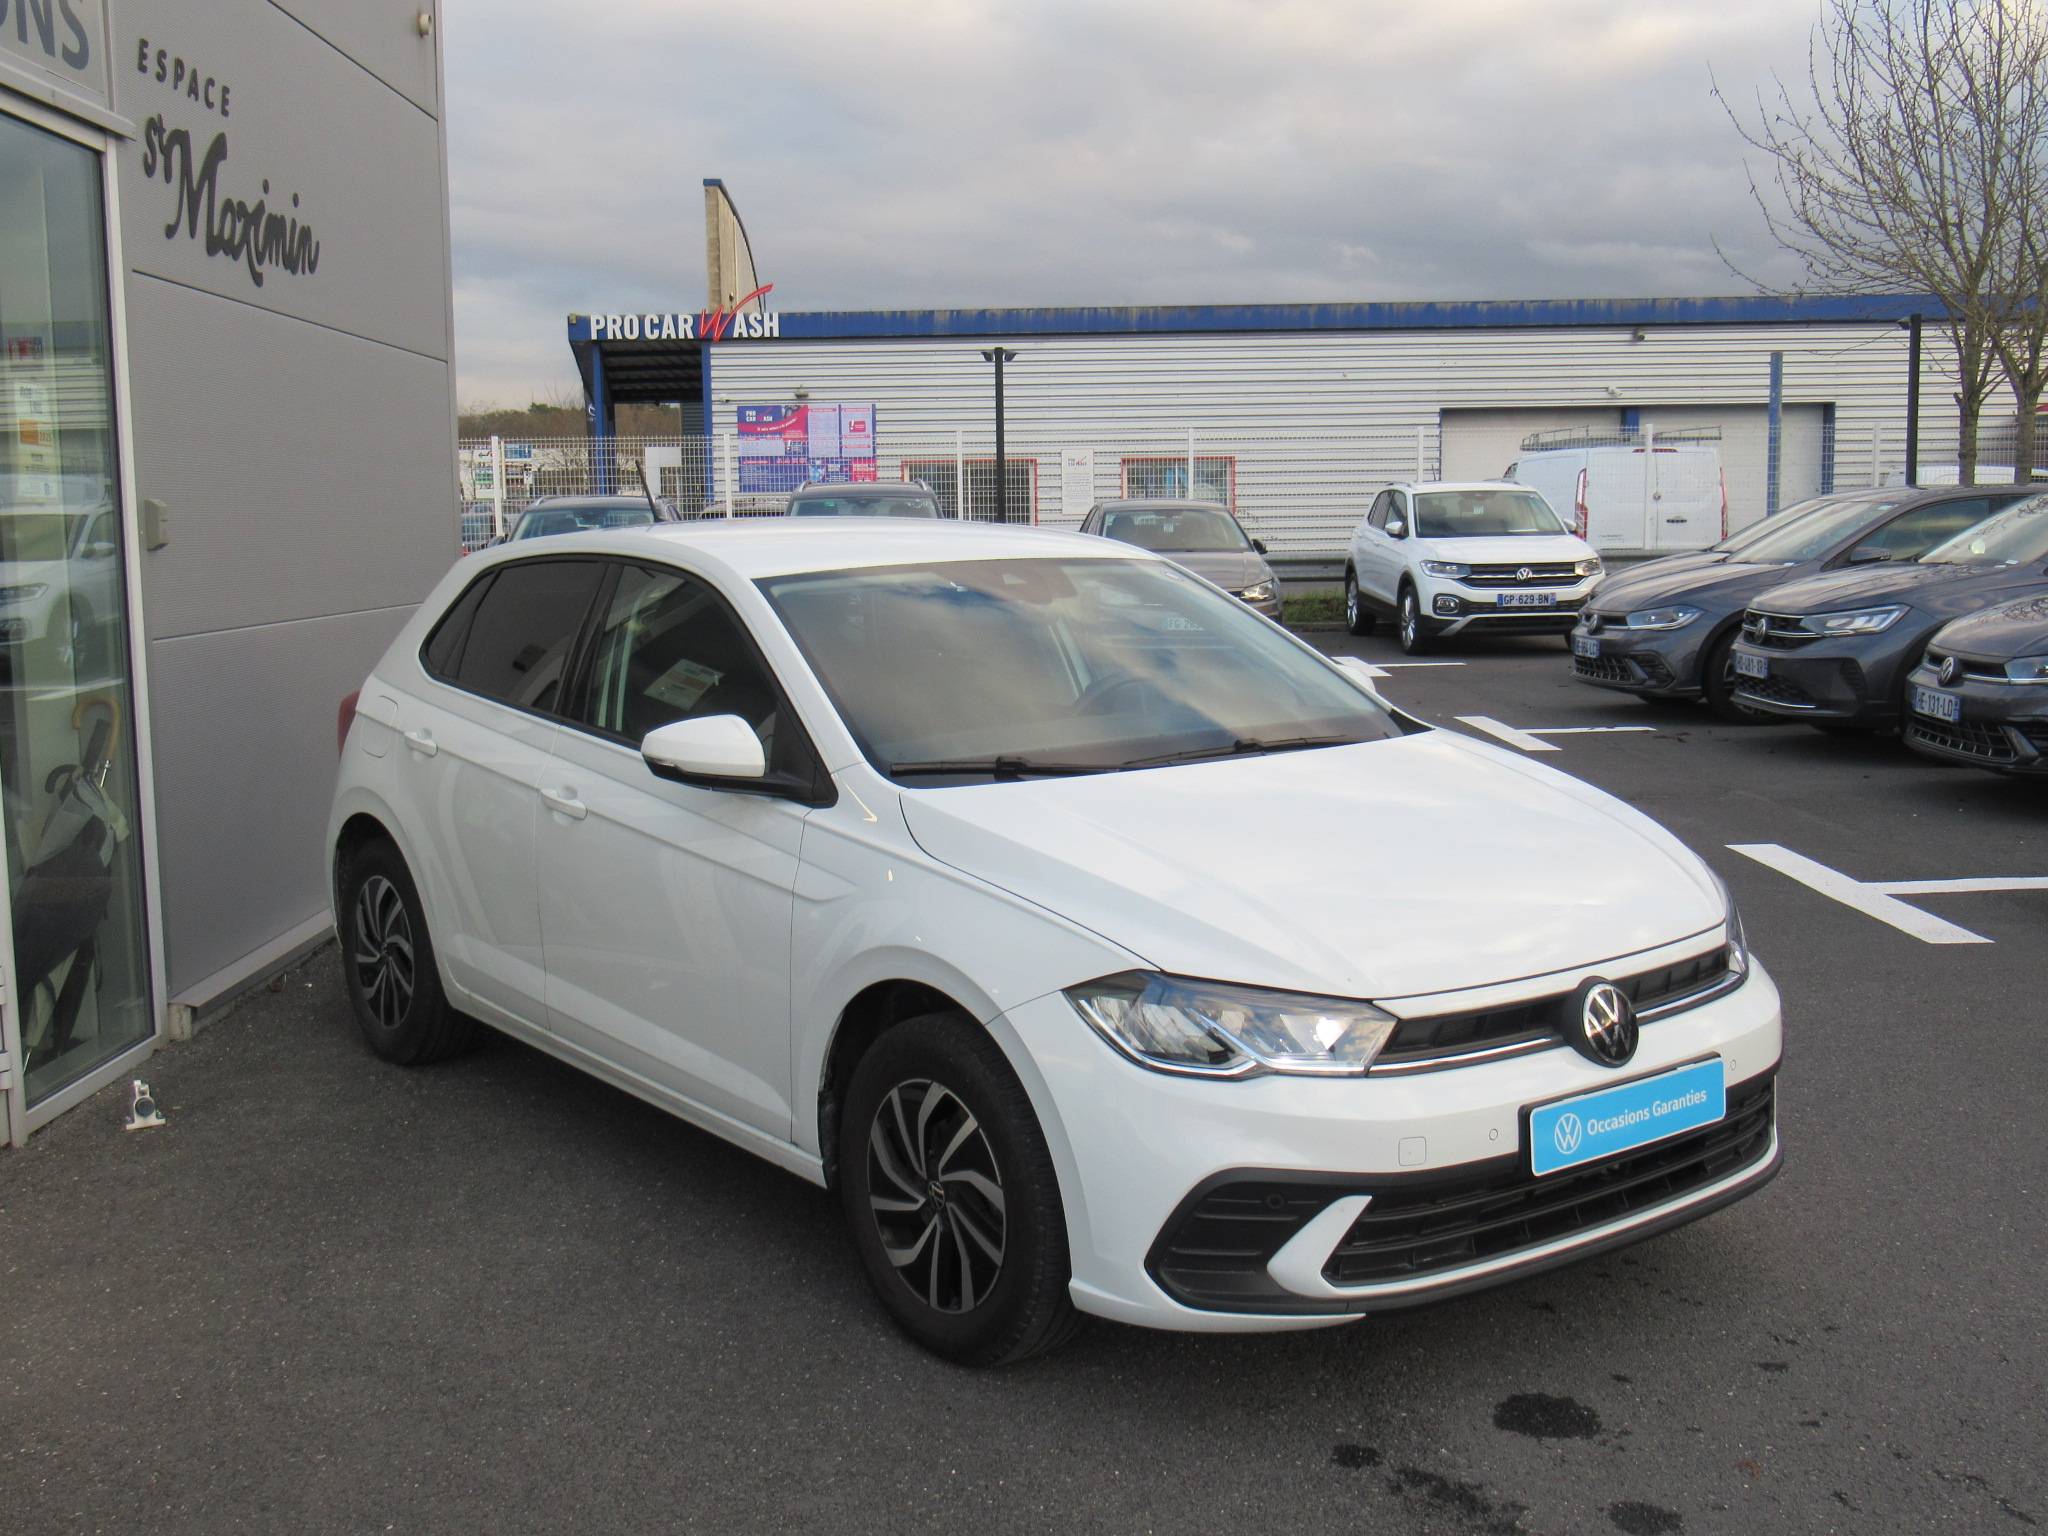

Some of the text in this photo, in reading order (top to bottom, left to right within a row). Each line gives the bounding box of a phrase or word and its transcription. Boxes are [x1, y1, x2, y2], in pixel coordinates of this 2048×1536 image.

[0, 0, 89, 71] NS
[138, 38, 230, 117] ESPACE
[163, 129, 320, 288] Maximin
[590, 288, 780, 342] PRO CAR WASH
[1587, 1104, 1650, 1136] Occasions
[1652, 1088, 1707, 1117] Garanties
